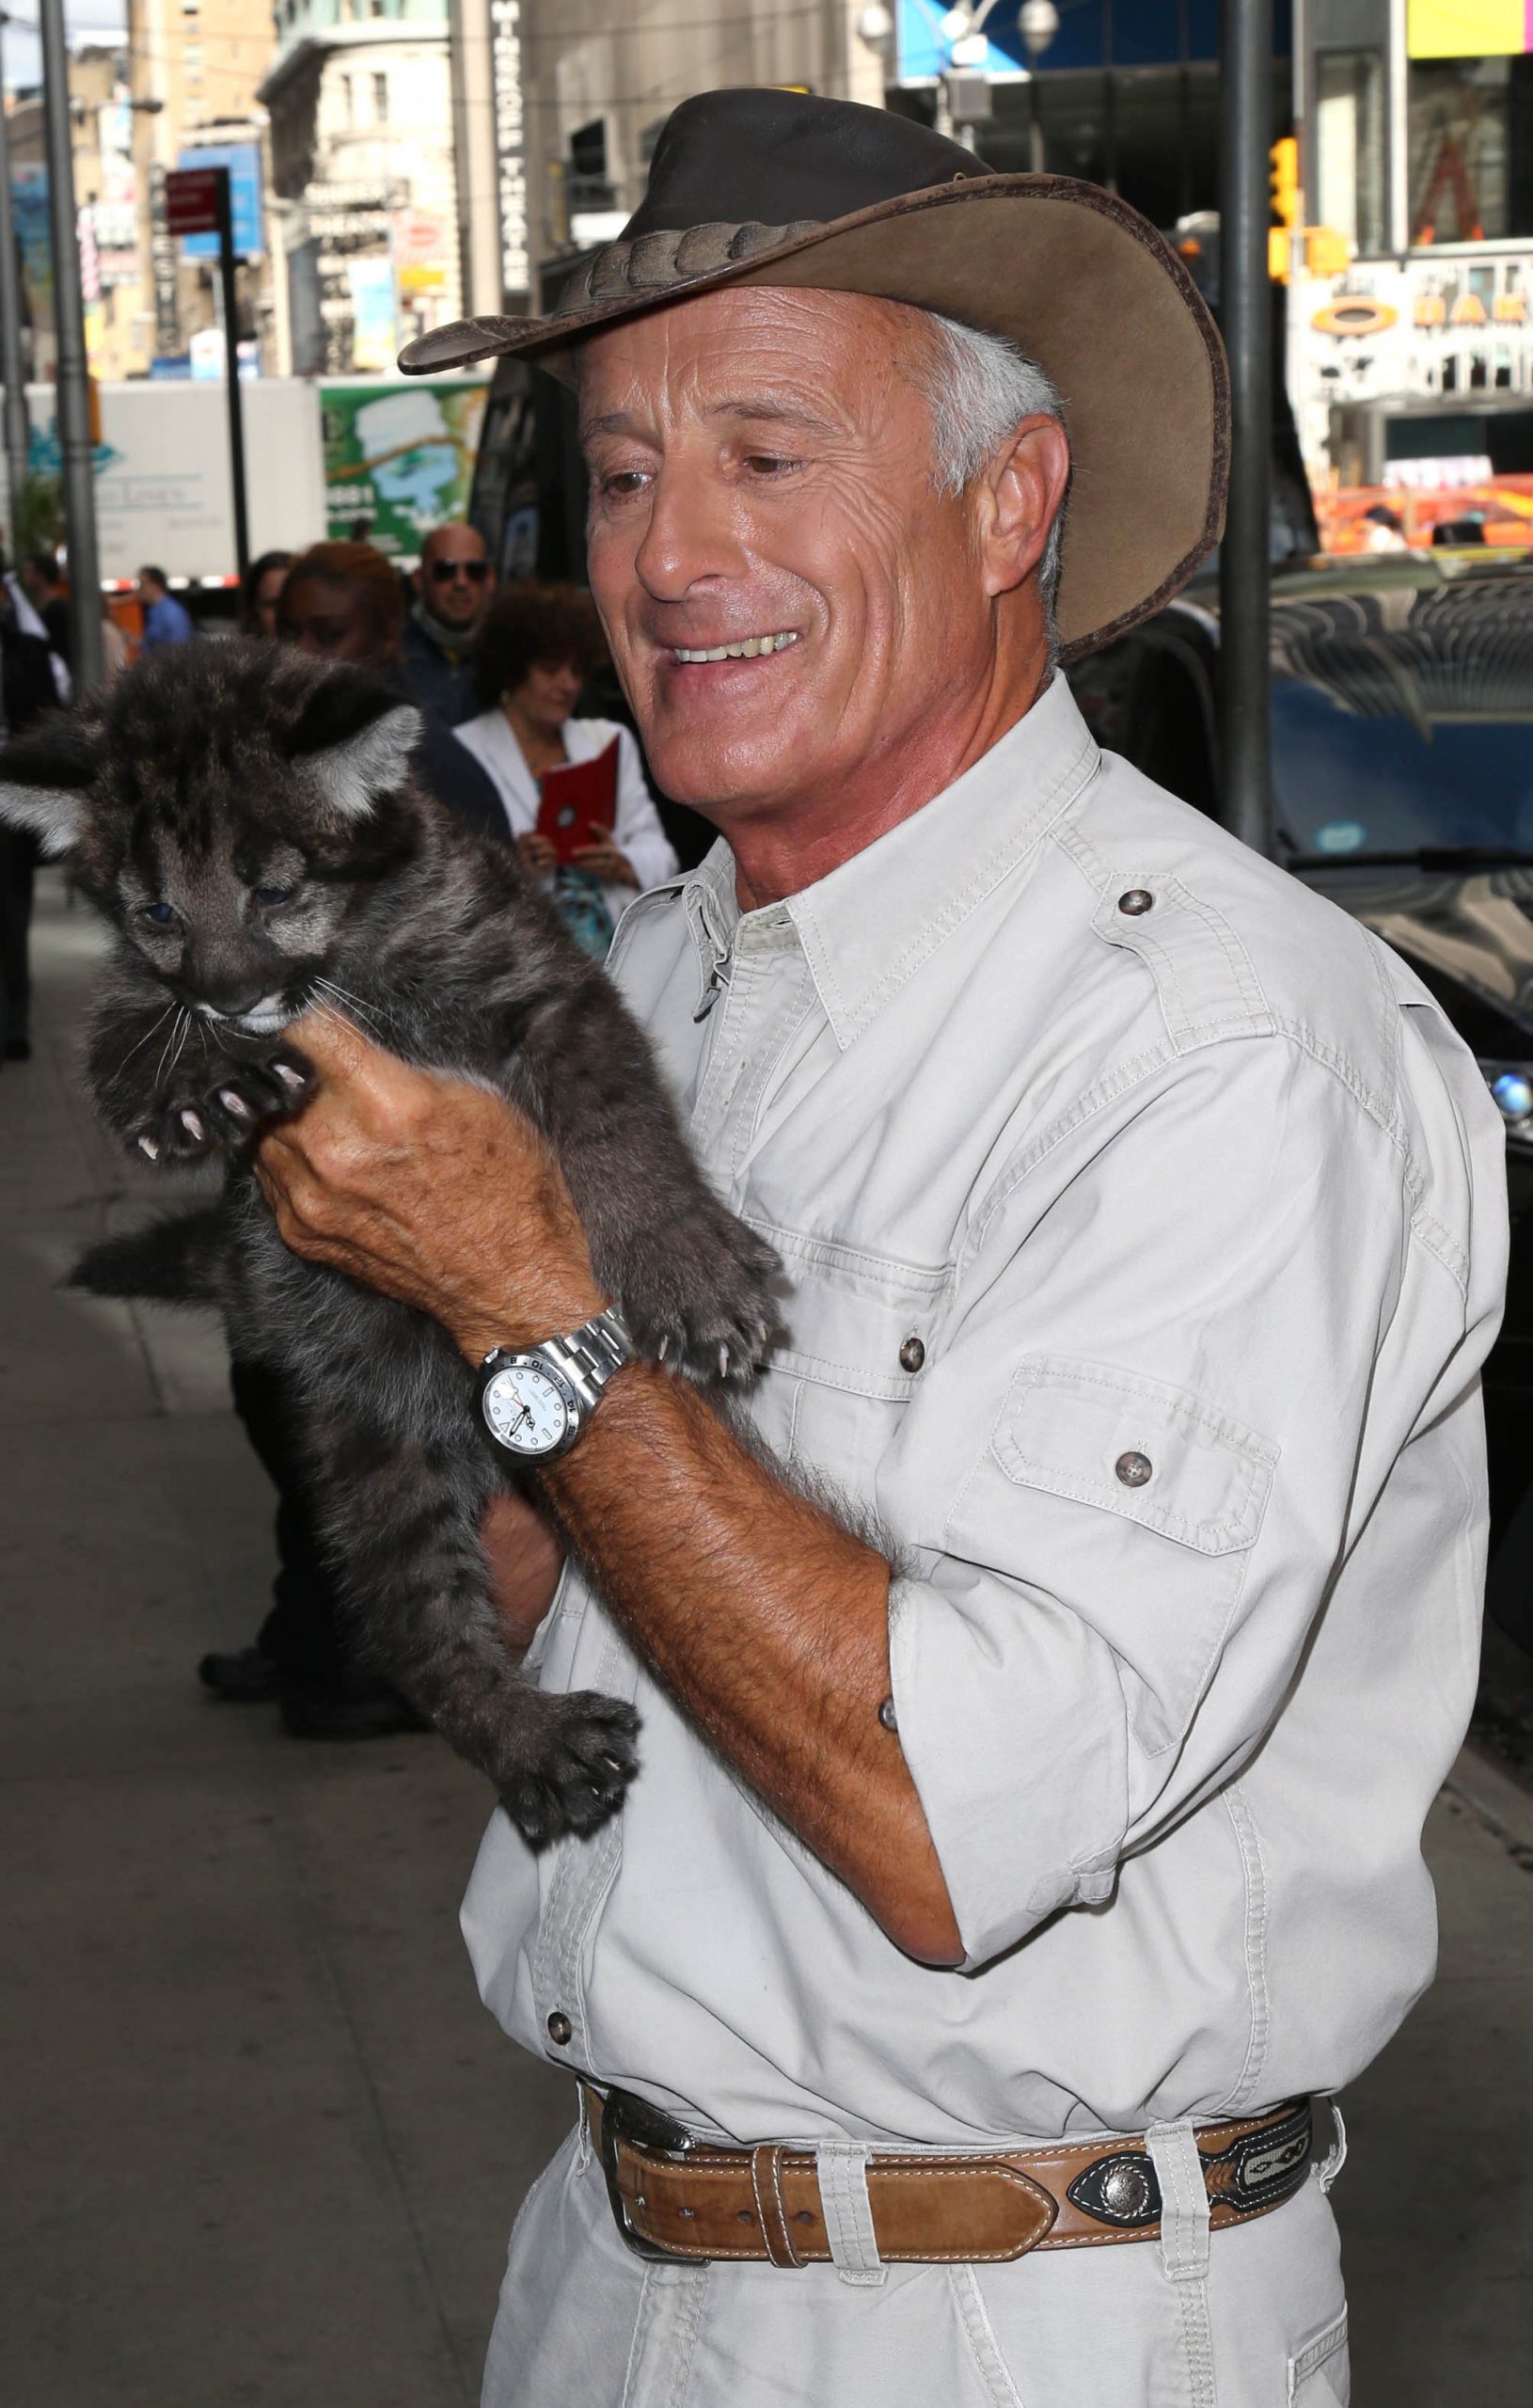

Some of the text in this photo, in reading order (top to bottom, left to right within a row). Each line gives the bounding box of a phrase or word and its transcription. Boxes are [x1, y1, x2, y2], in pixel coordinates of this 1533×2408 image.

[491, 0, 529, 291] MINSKOFF THEATRE
[531, 1359, 544, 1370] 10
[553, 1376, 565, 1388] 12
[566, 1400, 577, 1413] 14
